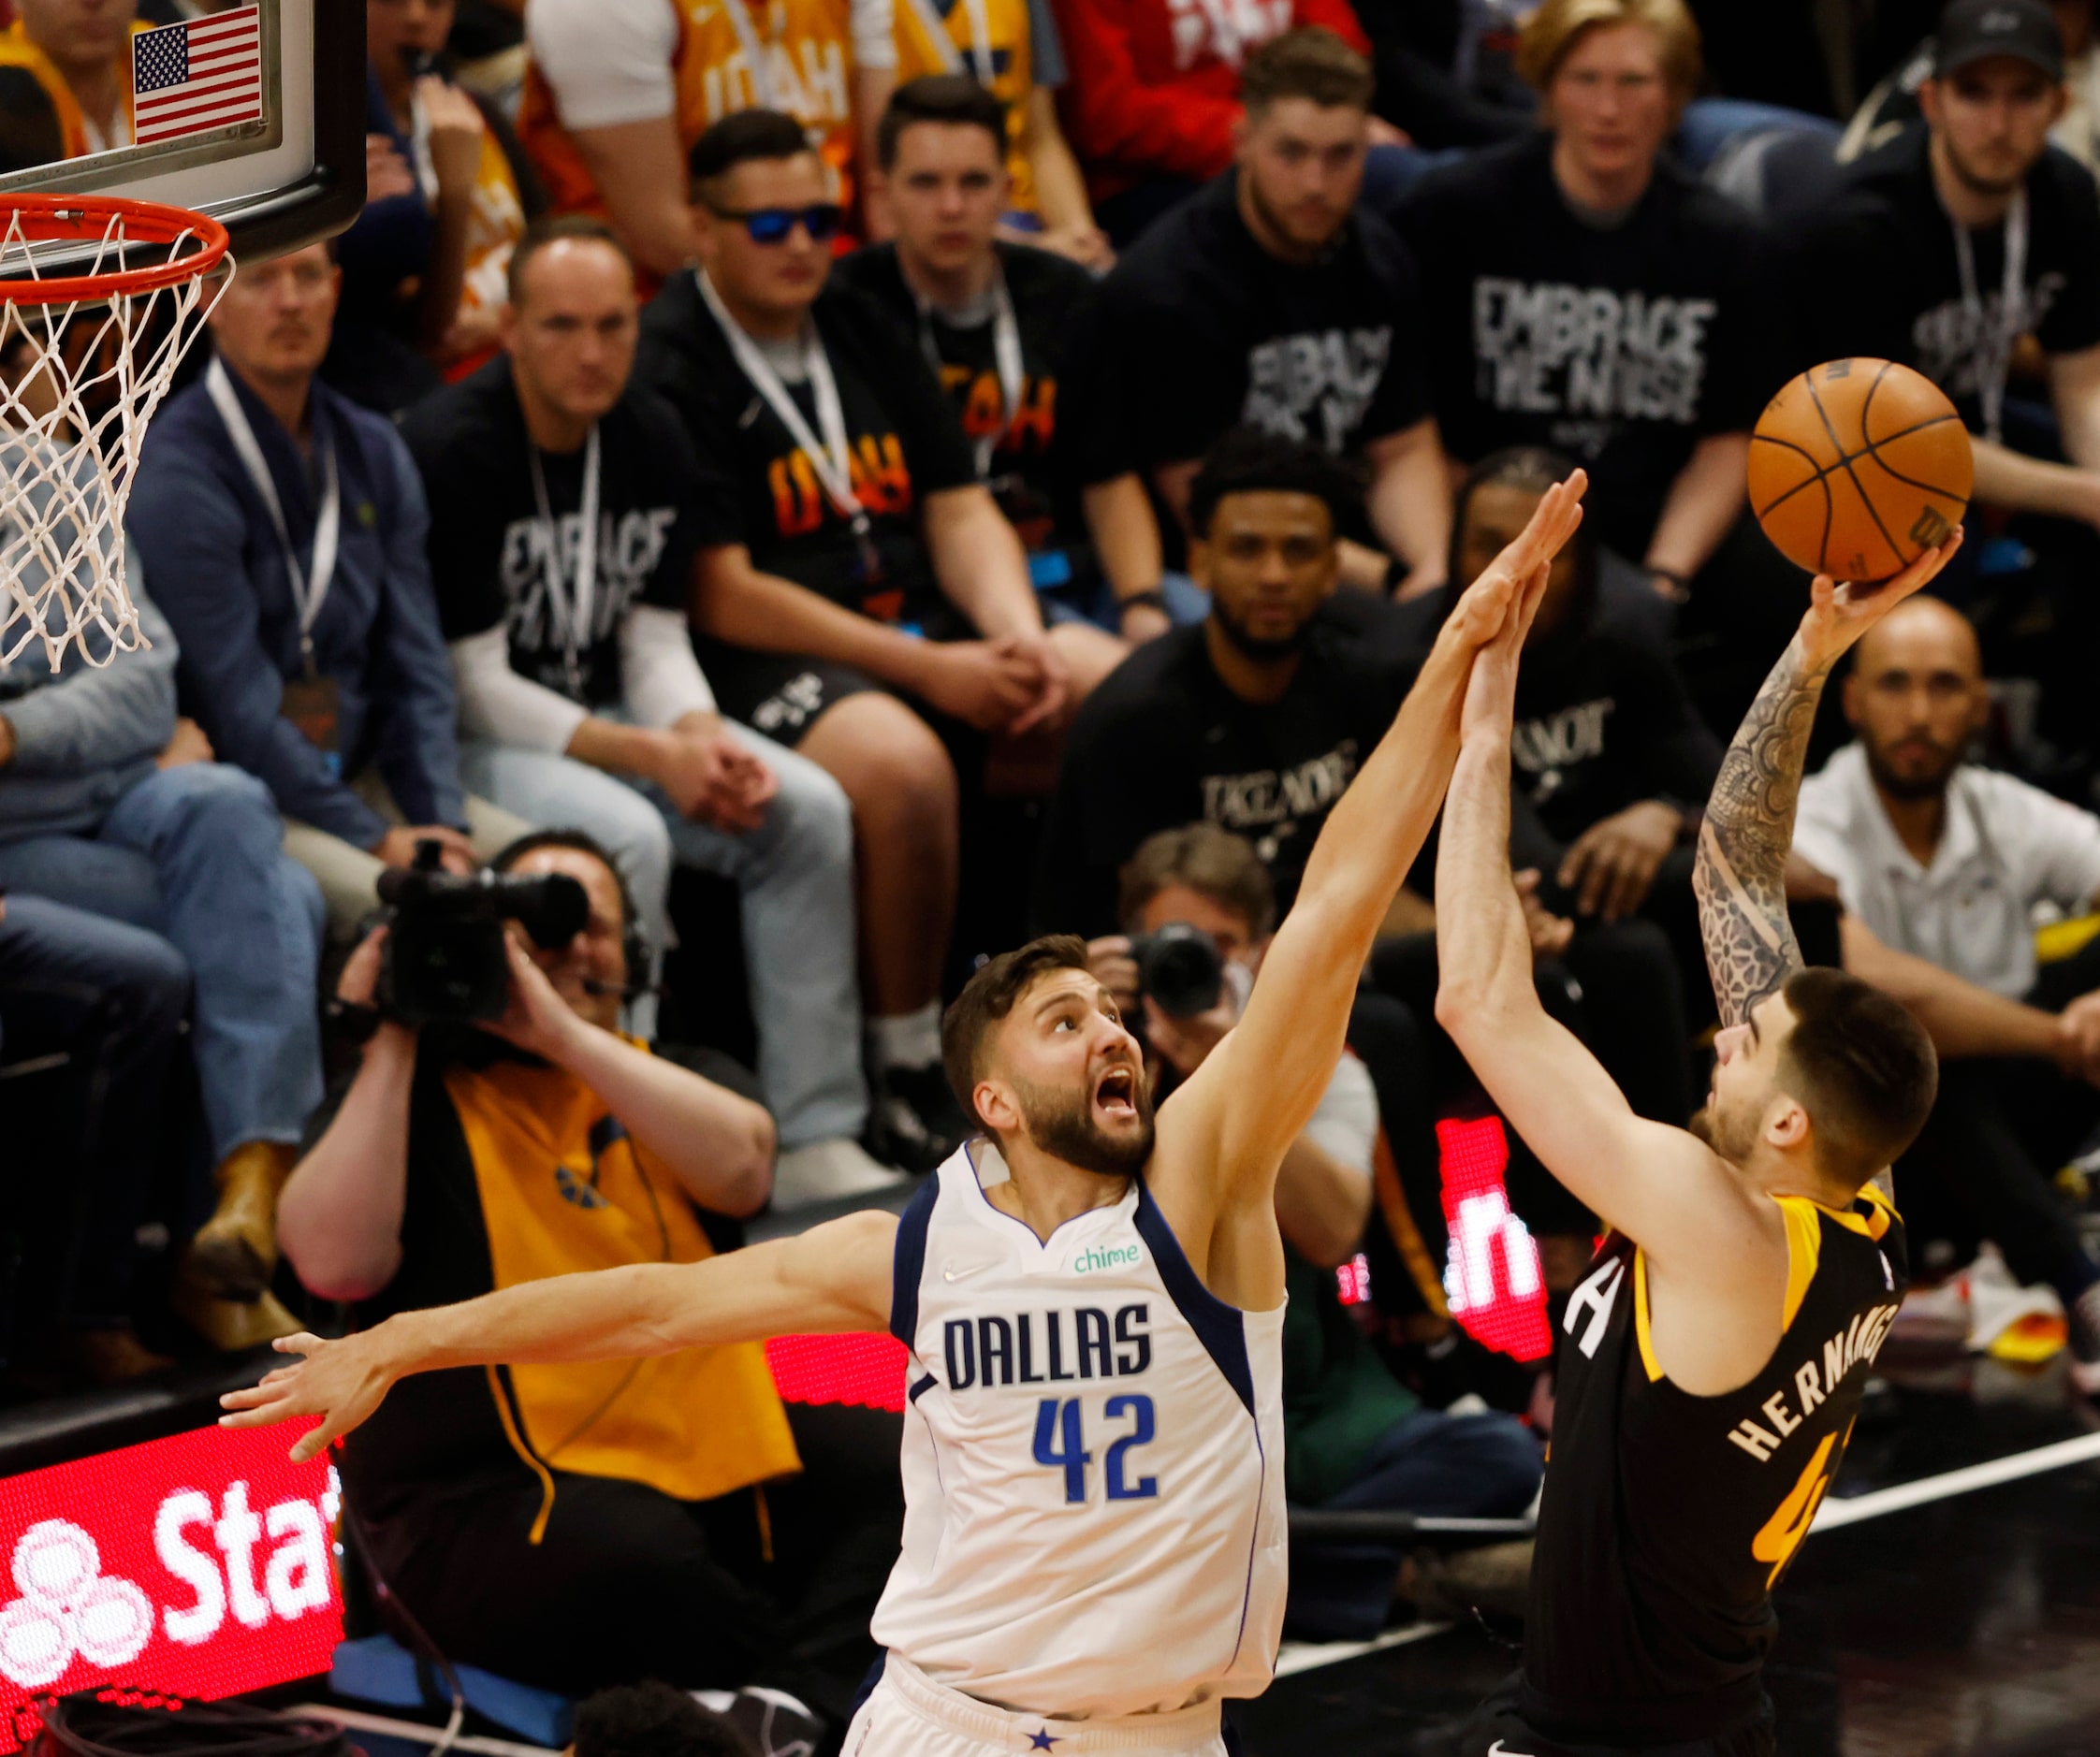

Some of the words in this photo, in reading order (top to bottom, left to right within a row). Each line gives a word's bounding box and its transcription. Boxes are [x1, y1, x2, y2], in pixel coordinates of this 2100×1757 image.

[704, 39, 849, 124] UAH
[768, 433, 911, 536] UAH
[1074, 1243, 1140, 1273] chime
[943, 1302, 1152, 1392] DALLAS
[1031, 1393, 1159, 1505] 42
